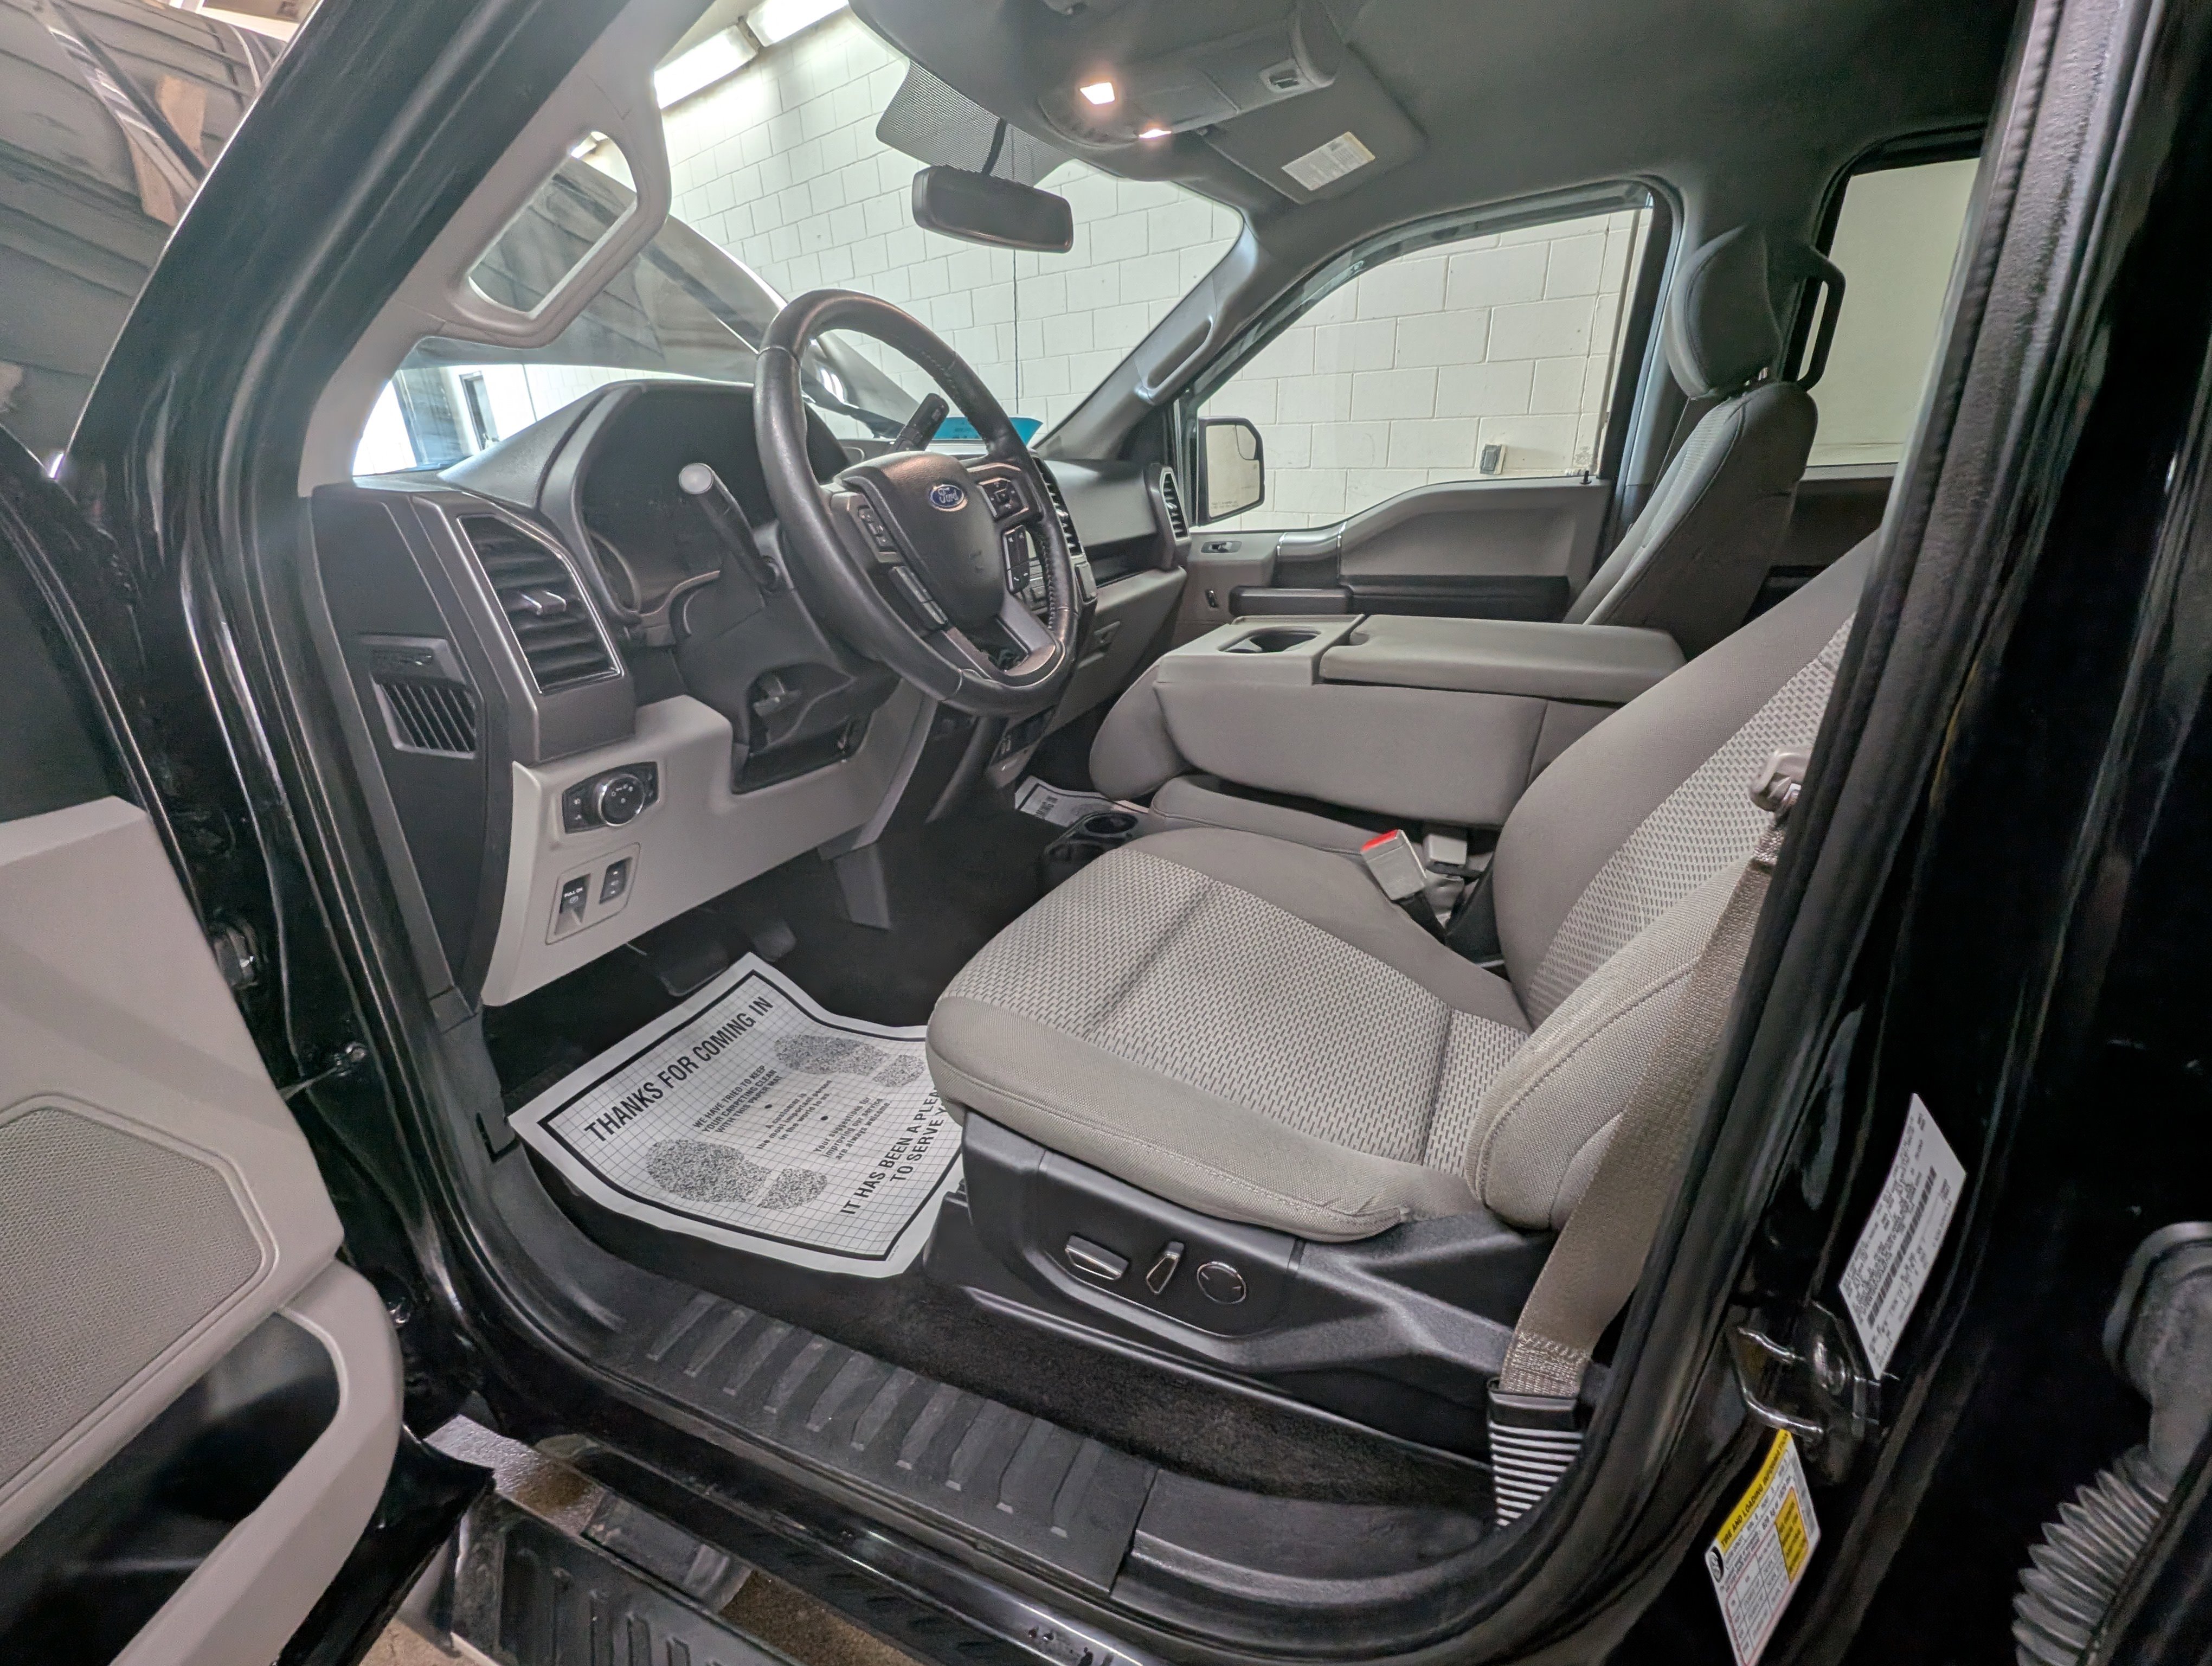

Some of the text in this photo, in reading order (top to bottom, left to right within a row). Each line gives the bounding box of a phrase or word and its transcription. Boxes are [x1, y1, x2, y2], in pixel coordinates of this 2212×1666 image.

[938, 487, 959, 503] Ford
[584, 996, 773, 1142] THANKS FOR COMING IN
[692, 1065, 766, 1128] WE HAVE TRIED TO KEEP
[702, 1069, 777, 1132] YOUR CARPETING CLEAN
[715, 1075, 783, 1133] WITH THIS PAPER MAT
[756, 1139, 770, 1149] the
[769, 1124, 786, 1138] most
[785, 1097, 814, 1123] important
[772, 1099, 800, 1124] customer
[786, 1123, 799, 1132] the
[797, 1107, 815, 1122] world
[813, 1097, 871, 1153] Your suggestions for
[822, 1098, 883, 1158] improving our service
[835, 1149, 848, 1160] are
[846, 1127, 867, 1148] always
[840, 1200, 861, 1214] IT
[854, 1171, 886, 1198] HAS
[878, 1137, 914, 1168] BEEN
[906, 1125, 922, 1133] A
[889, 1165, 914, 1181] TO
[906, 1119, 944, 1161] SERVE
[1721, 1529, 1732, 1547] TIRE
[1732, 1515, 1742, 1533] AND
[1742, 1483, 1764, 1518] LOADING
